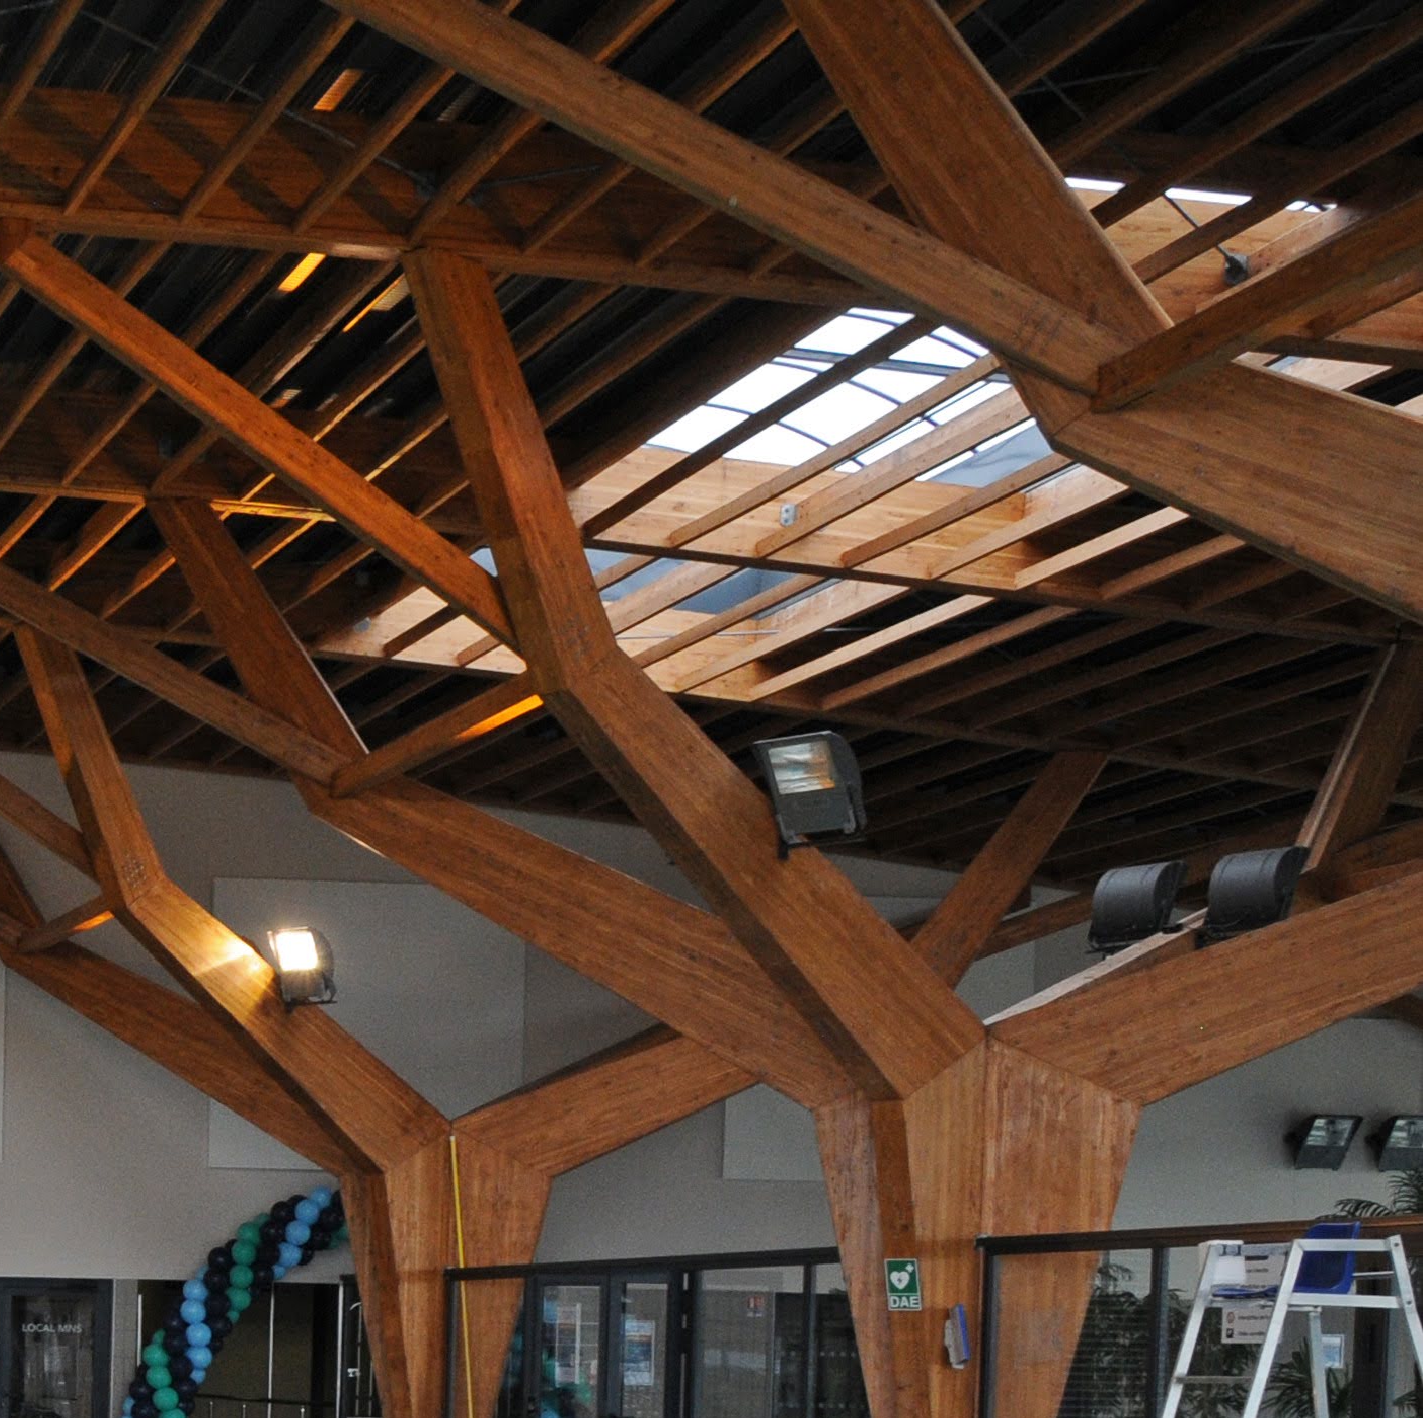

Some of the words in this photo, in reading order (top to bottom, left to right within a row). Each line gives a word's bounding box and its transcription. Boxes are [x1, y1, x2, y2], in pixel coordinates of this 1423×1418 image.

[890, 1296, 920, 1308] DAE
[21, 1323, 55, 1333] LOCAL
[57, 1323, 83, 1334] MNS
